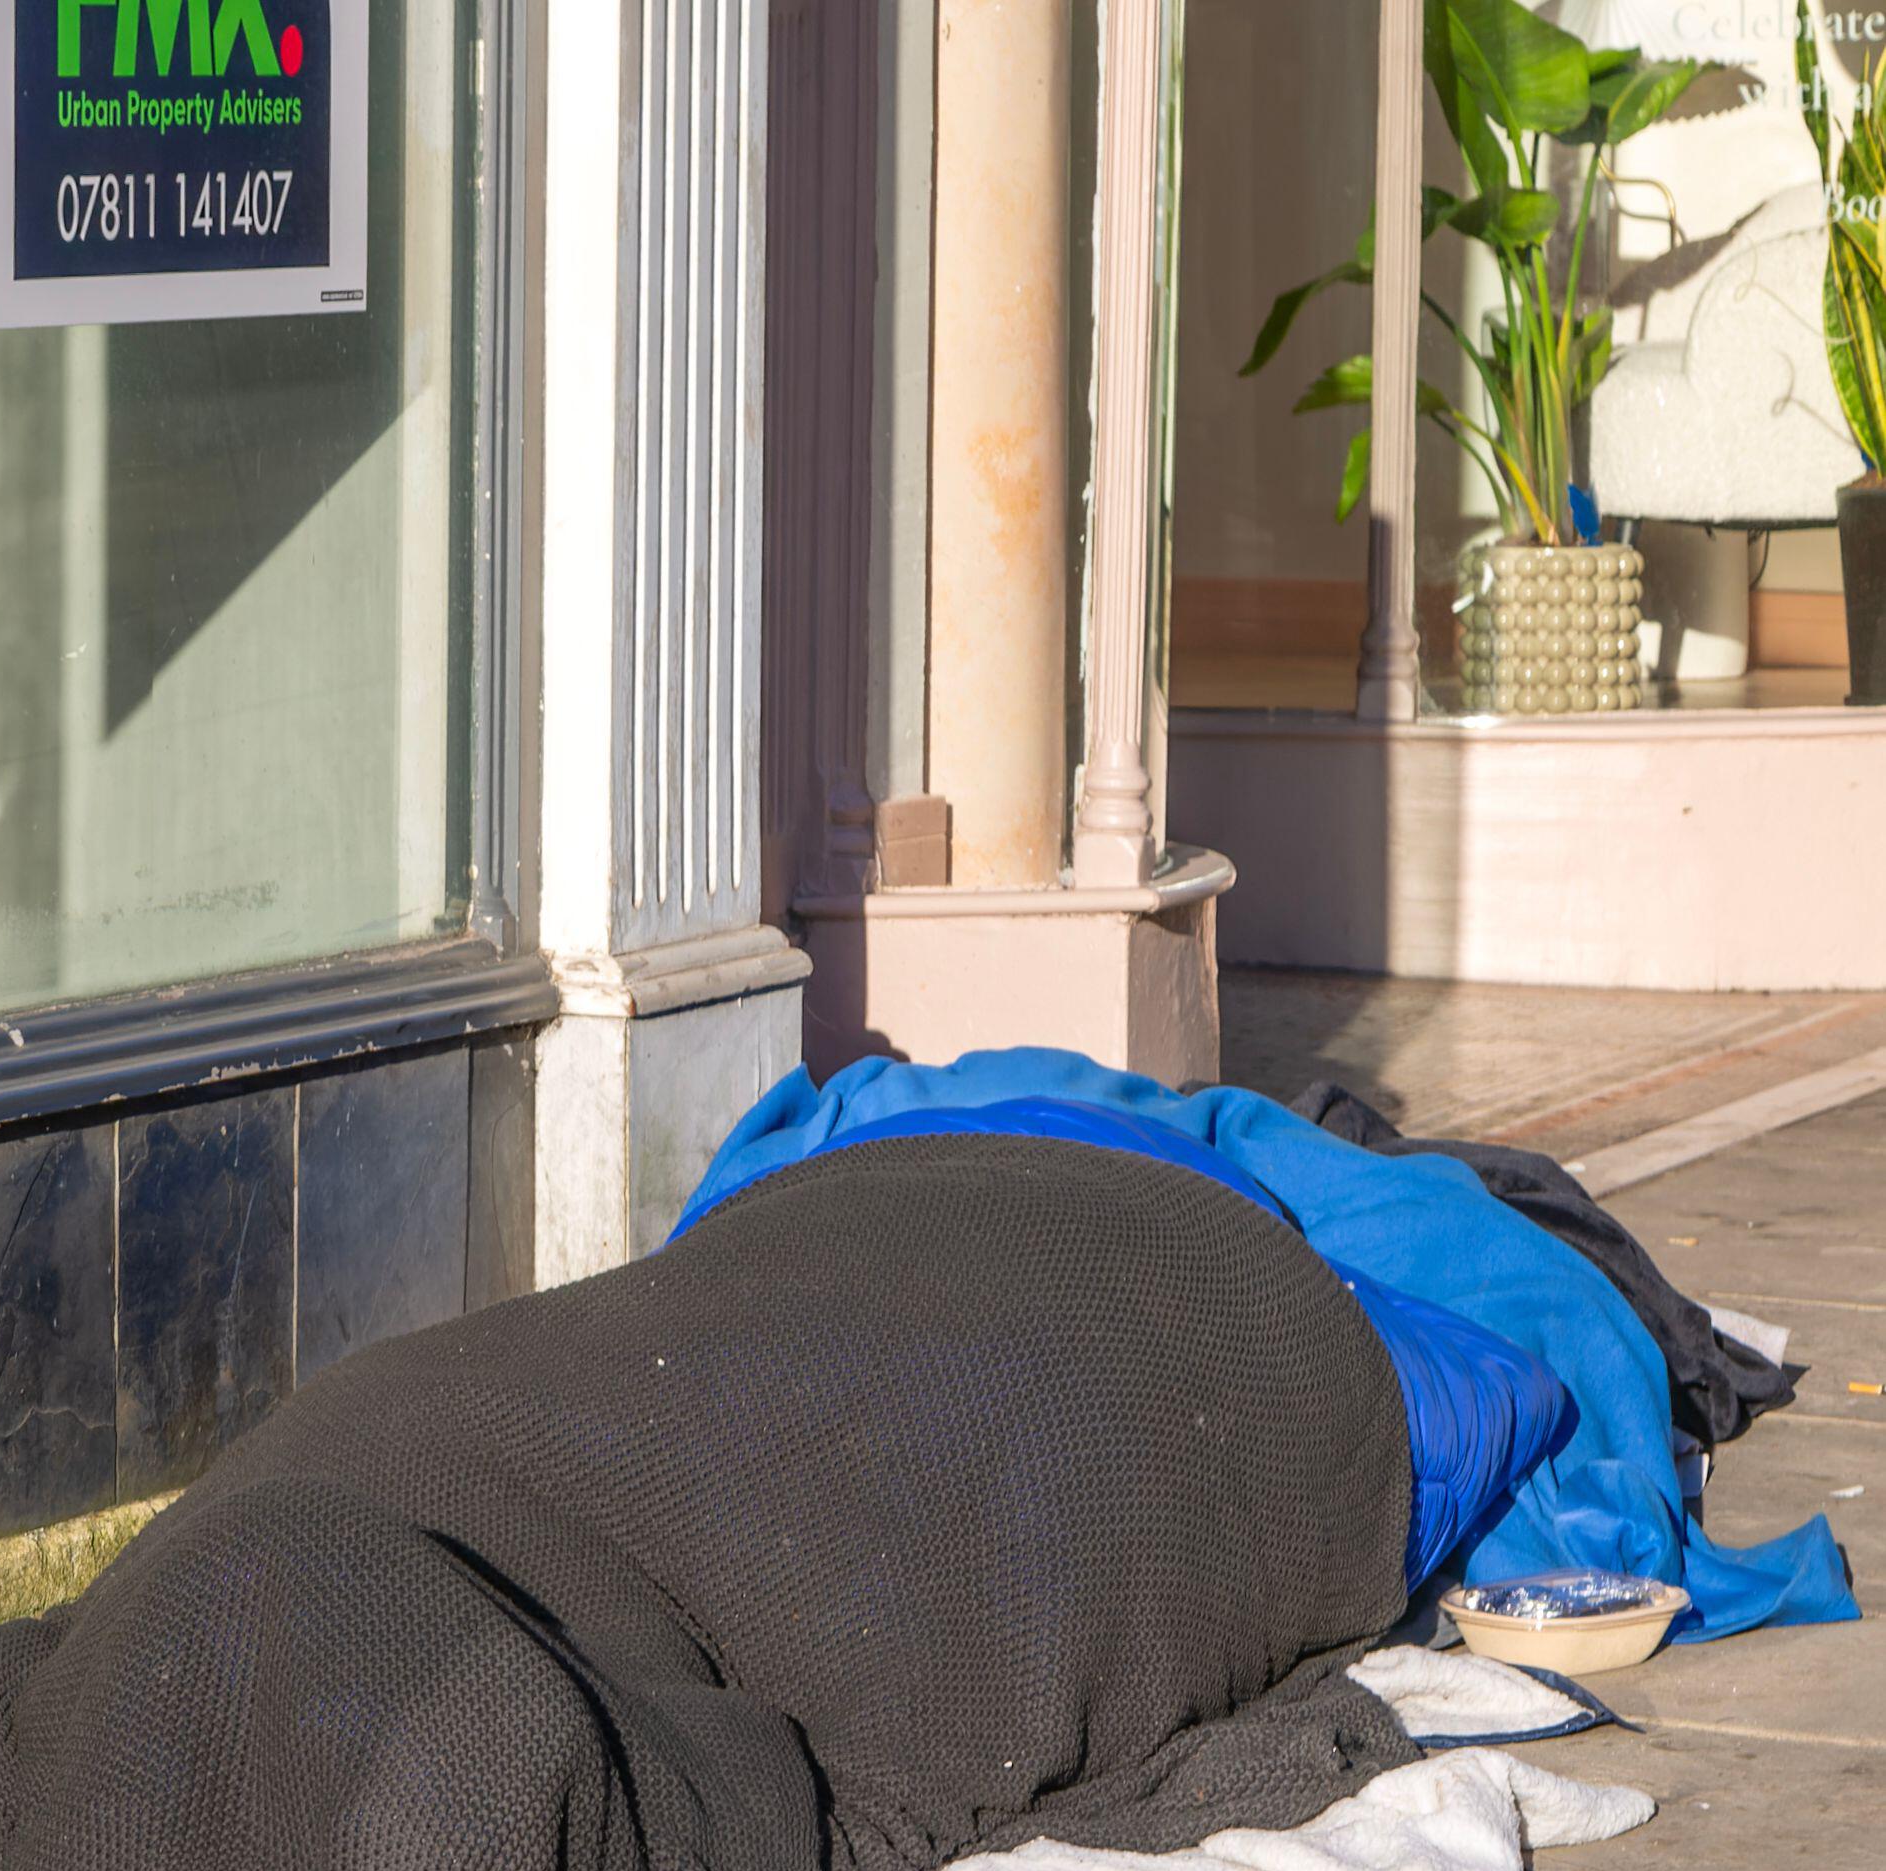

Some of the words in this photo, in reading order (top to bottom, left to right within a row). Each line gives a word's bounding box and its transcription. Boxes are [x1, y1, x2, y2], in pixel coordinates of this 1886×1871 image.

[58, 90, 121, 128] Urban
[128, 90, 215, 135] Property
[220, 88, 302, 125] Advisers
[57, 173, 155, 243] 07811
[176, 170, 293, 238] 141407
